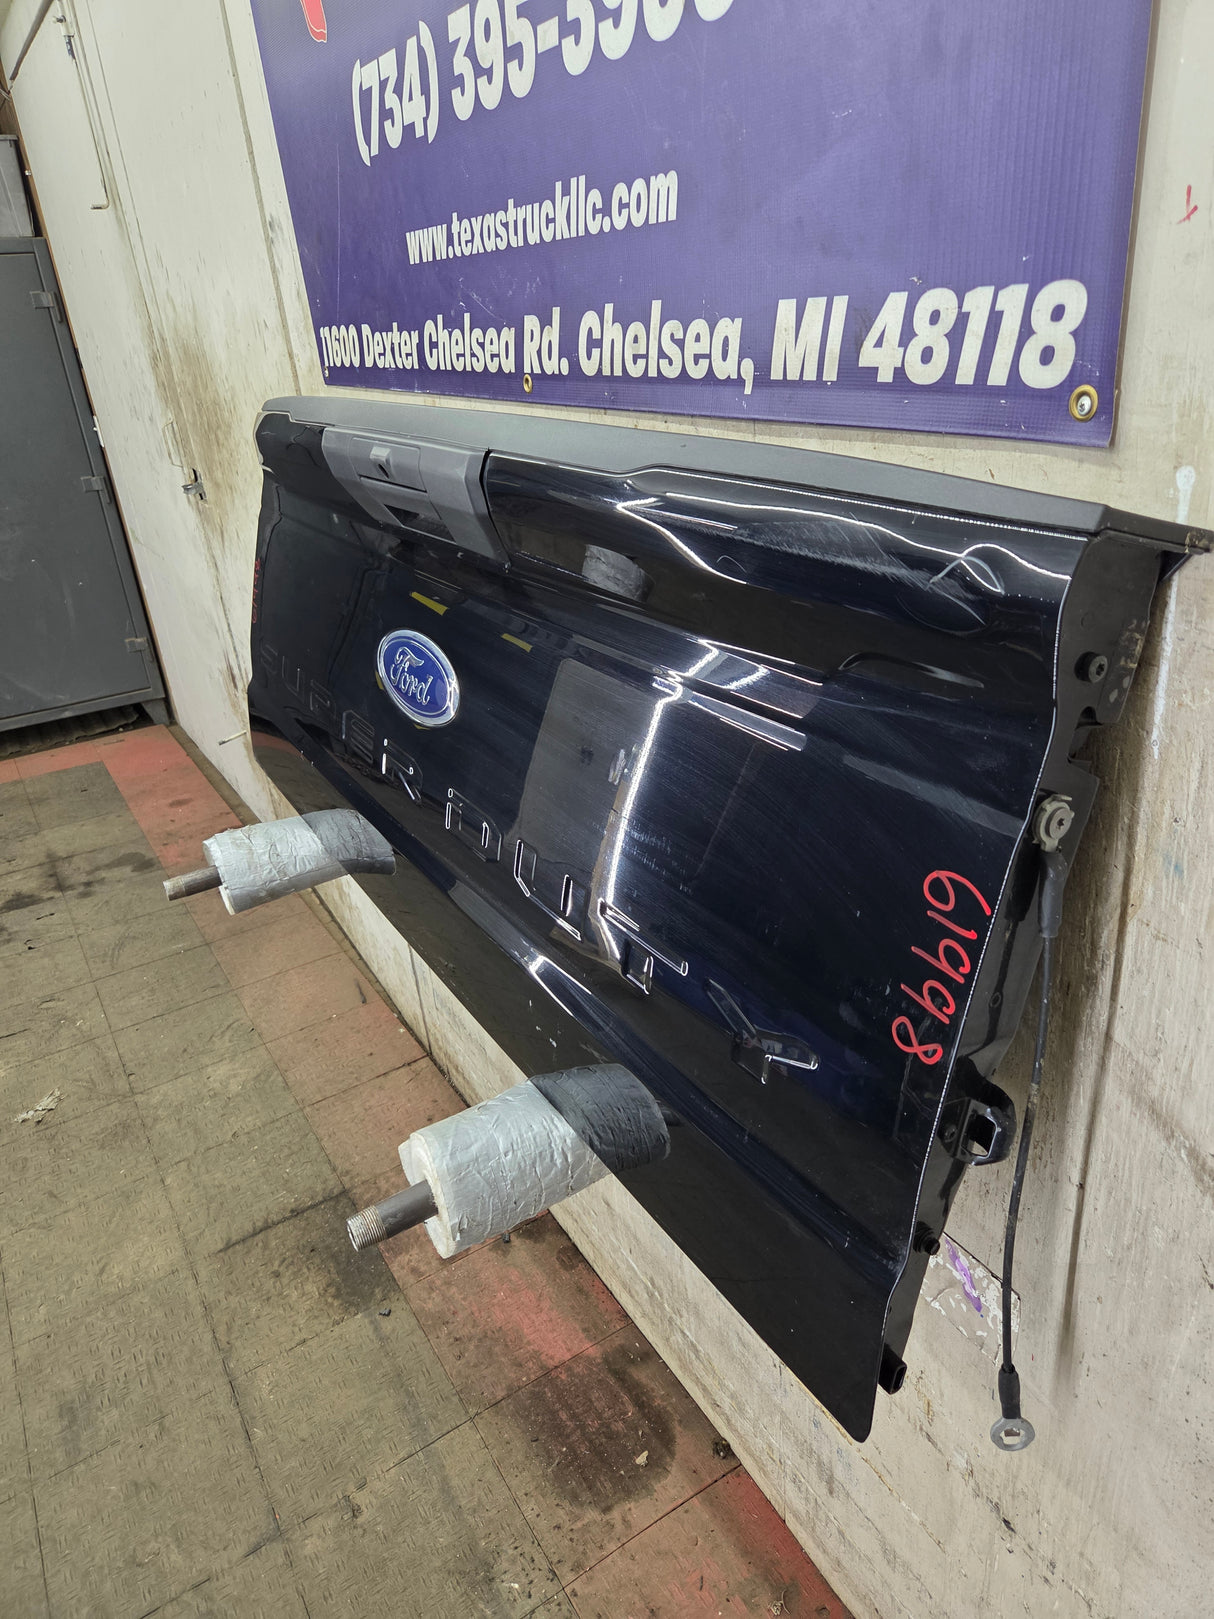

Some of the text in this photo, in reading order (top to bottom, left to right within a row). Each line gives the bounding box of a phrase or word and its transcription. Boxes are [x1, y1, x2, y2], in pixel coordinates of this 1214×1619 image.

[351, 20, 439, 167] (734)
[405, 169, 678, 265] www.texastruckllc.com
[319, 278, 1089, 395] 11600 Dexter Chelsea Rd. Chelsea, MI 48118
[389, 646, 434, 707] Ford
[257, 642, 820, 1086] SUPER DUTY
[891, 869, 993, 1066] 61998
